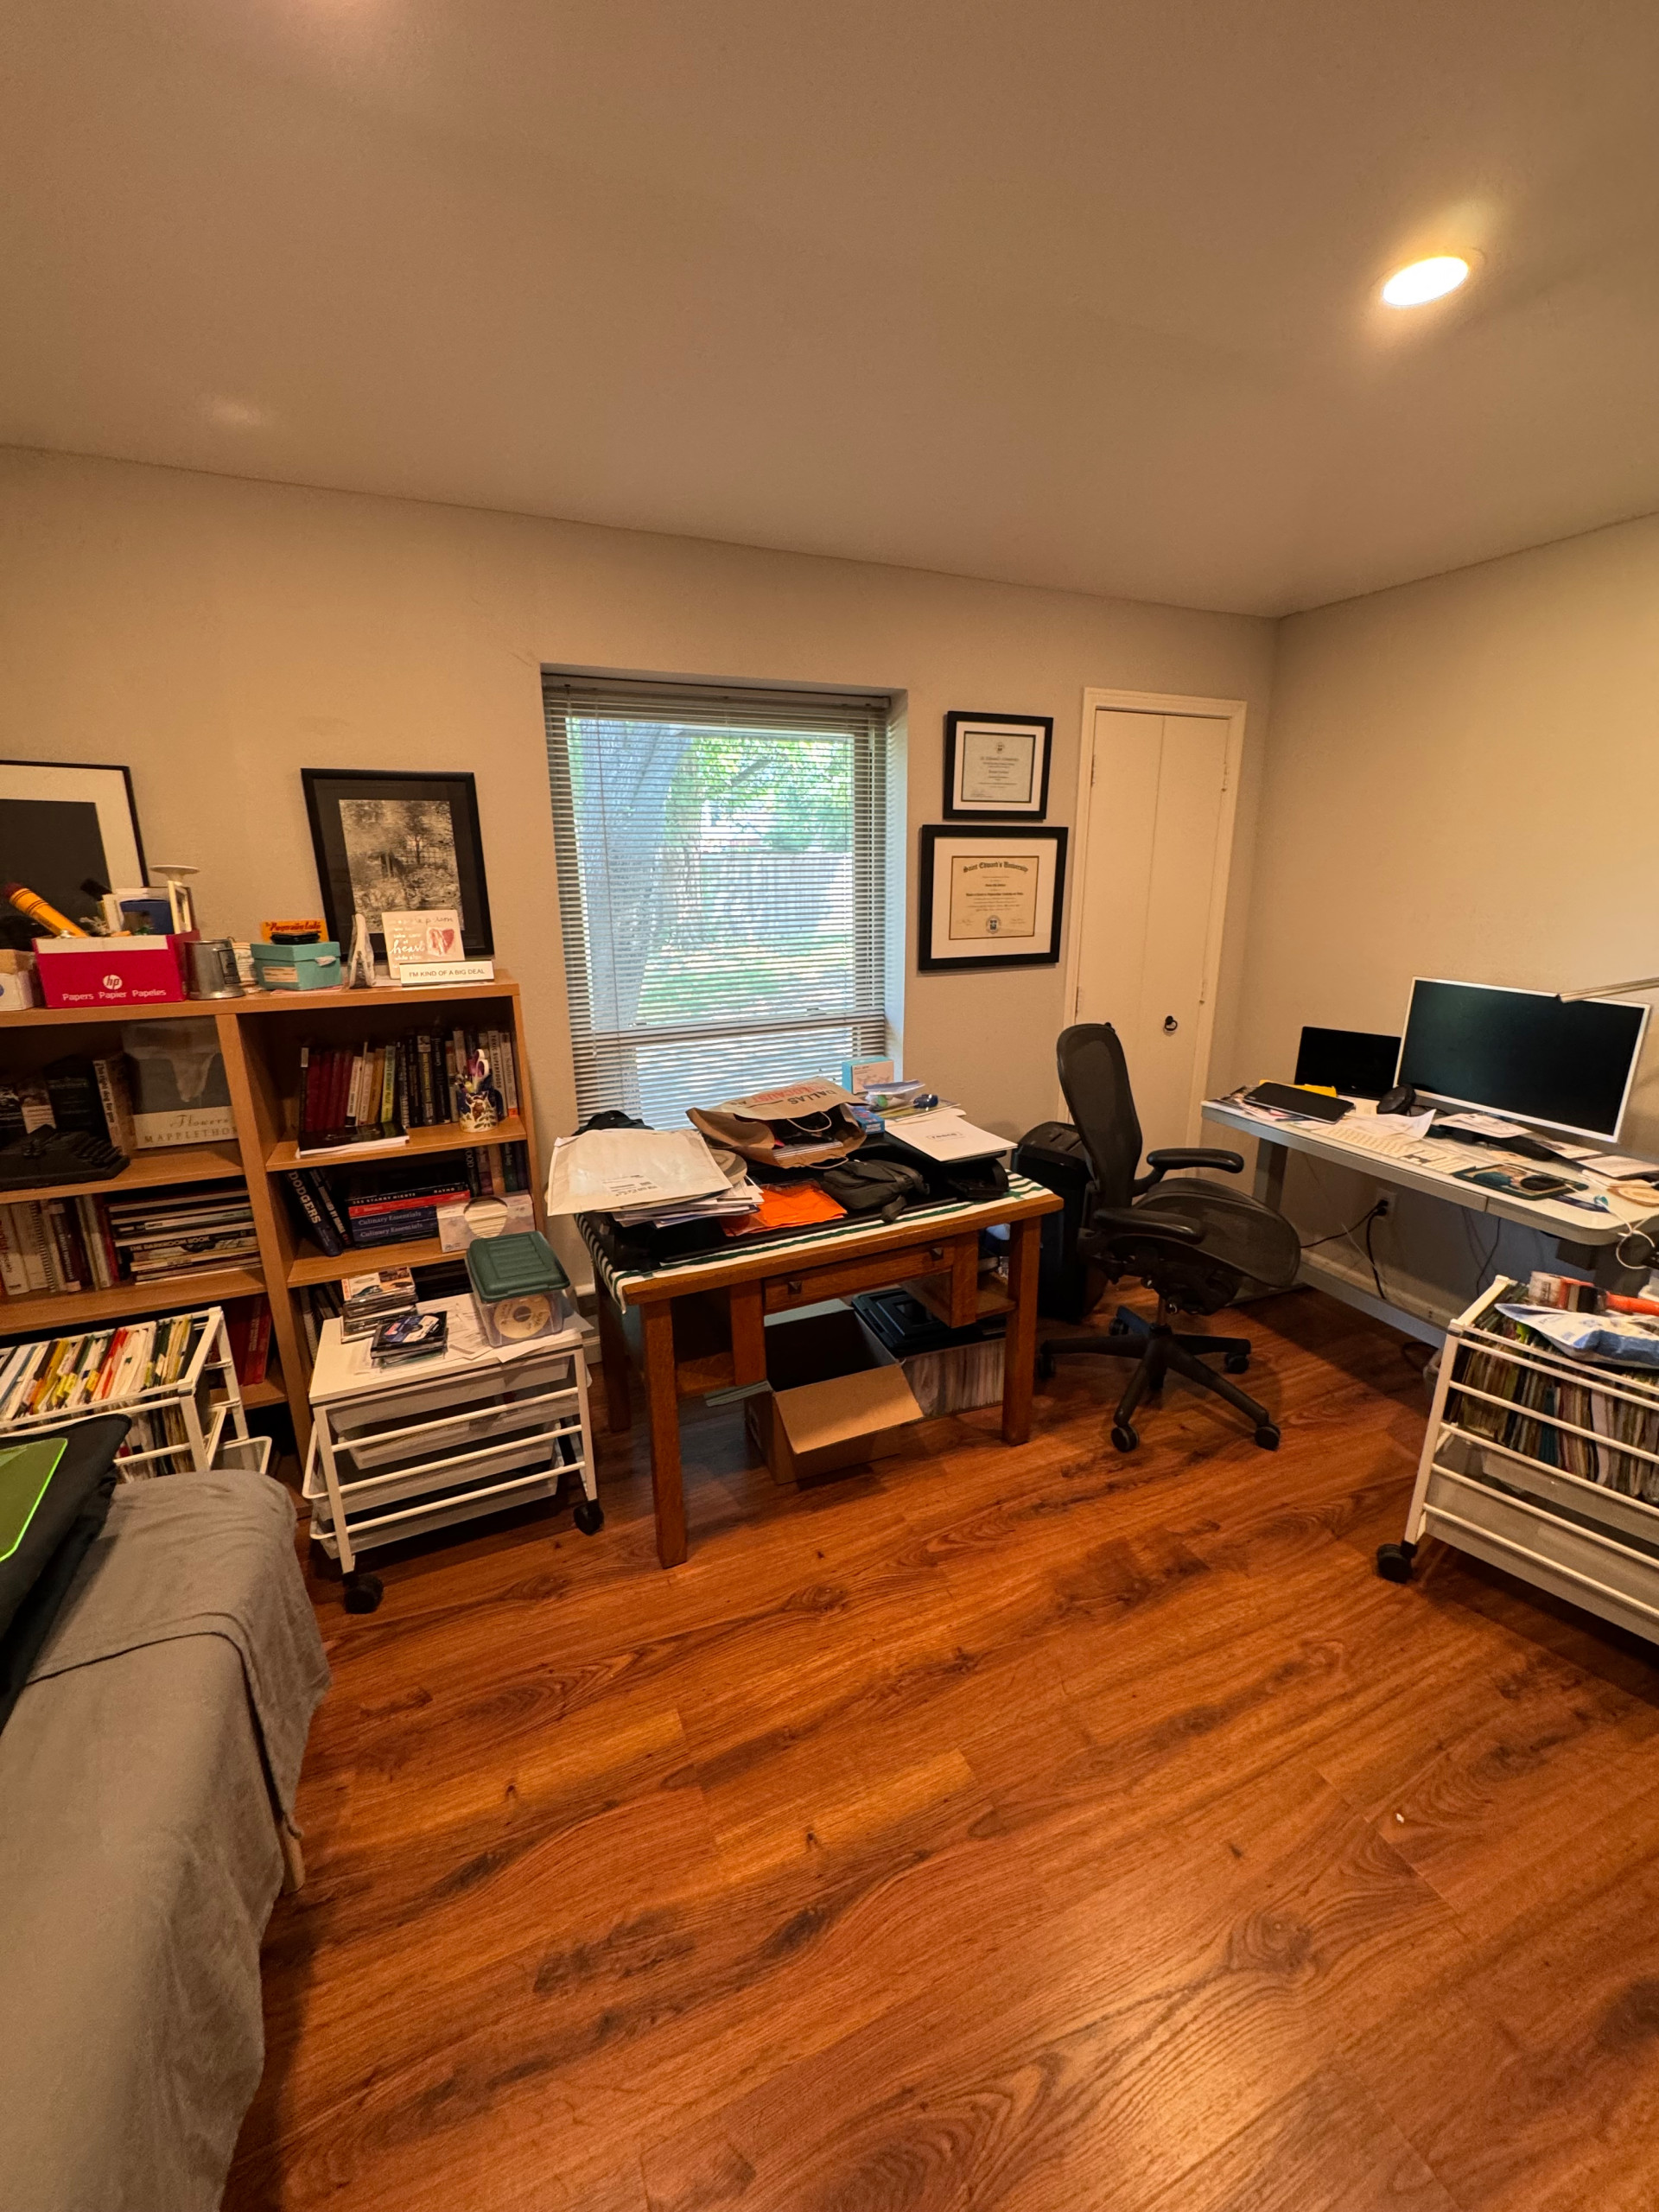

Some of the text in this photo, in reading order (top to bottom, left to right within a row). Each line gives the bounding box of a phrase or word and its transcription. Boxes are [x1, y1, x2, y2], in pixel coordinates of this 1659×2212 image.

[390, 939, 425, 954] heart
[106, 976, 119, 990] hp
[62, 988, 167, 1001] Papers Papier Papeles
[493, 1052, 501, 1089] SUPERFOODS
[99, 1076, 108, 1089] right
[106, 1112, 115, 1123] you
[787, 1090, 837, 1105] DALLAS
[170, 1115, 229, 1128] Flowers
[289, 1171, 321, 1224] DODGERS
[358, 1211, 422, 1226] Culinary Essentials
[359, 1223, 423, 1238] Culinary Essentials
[130, 1235, 211, 1252] THE DARKROOM BOOK
